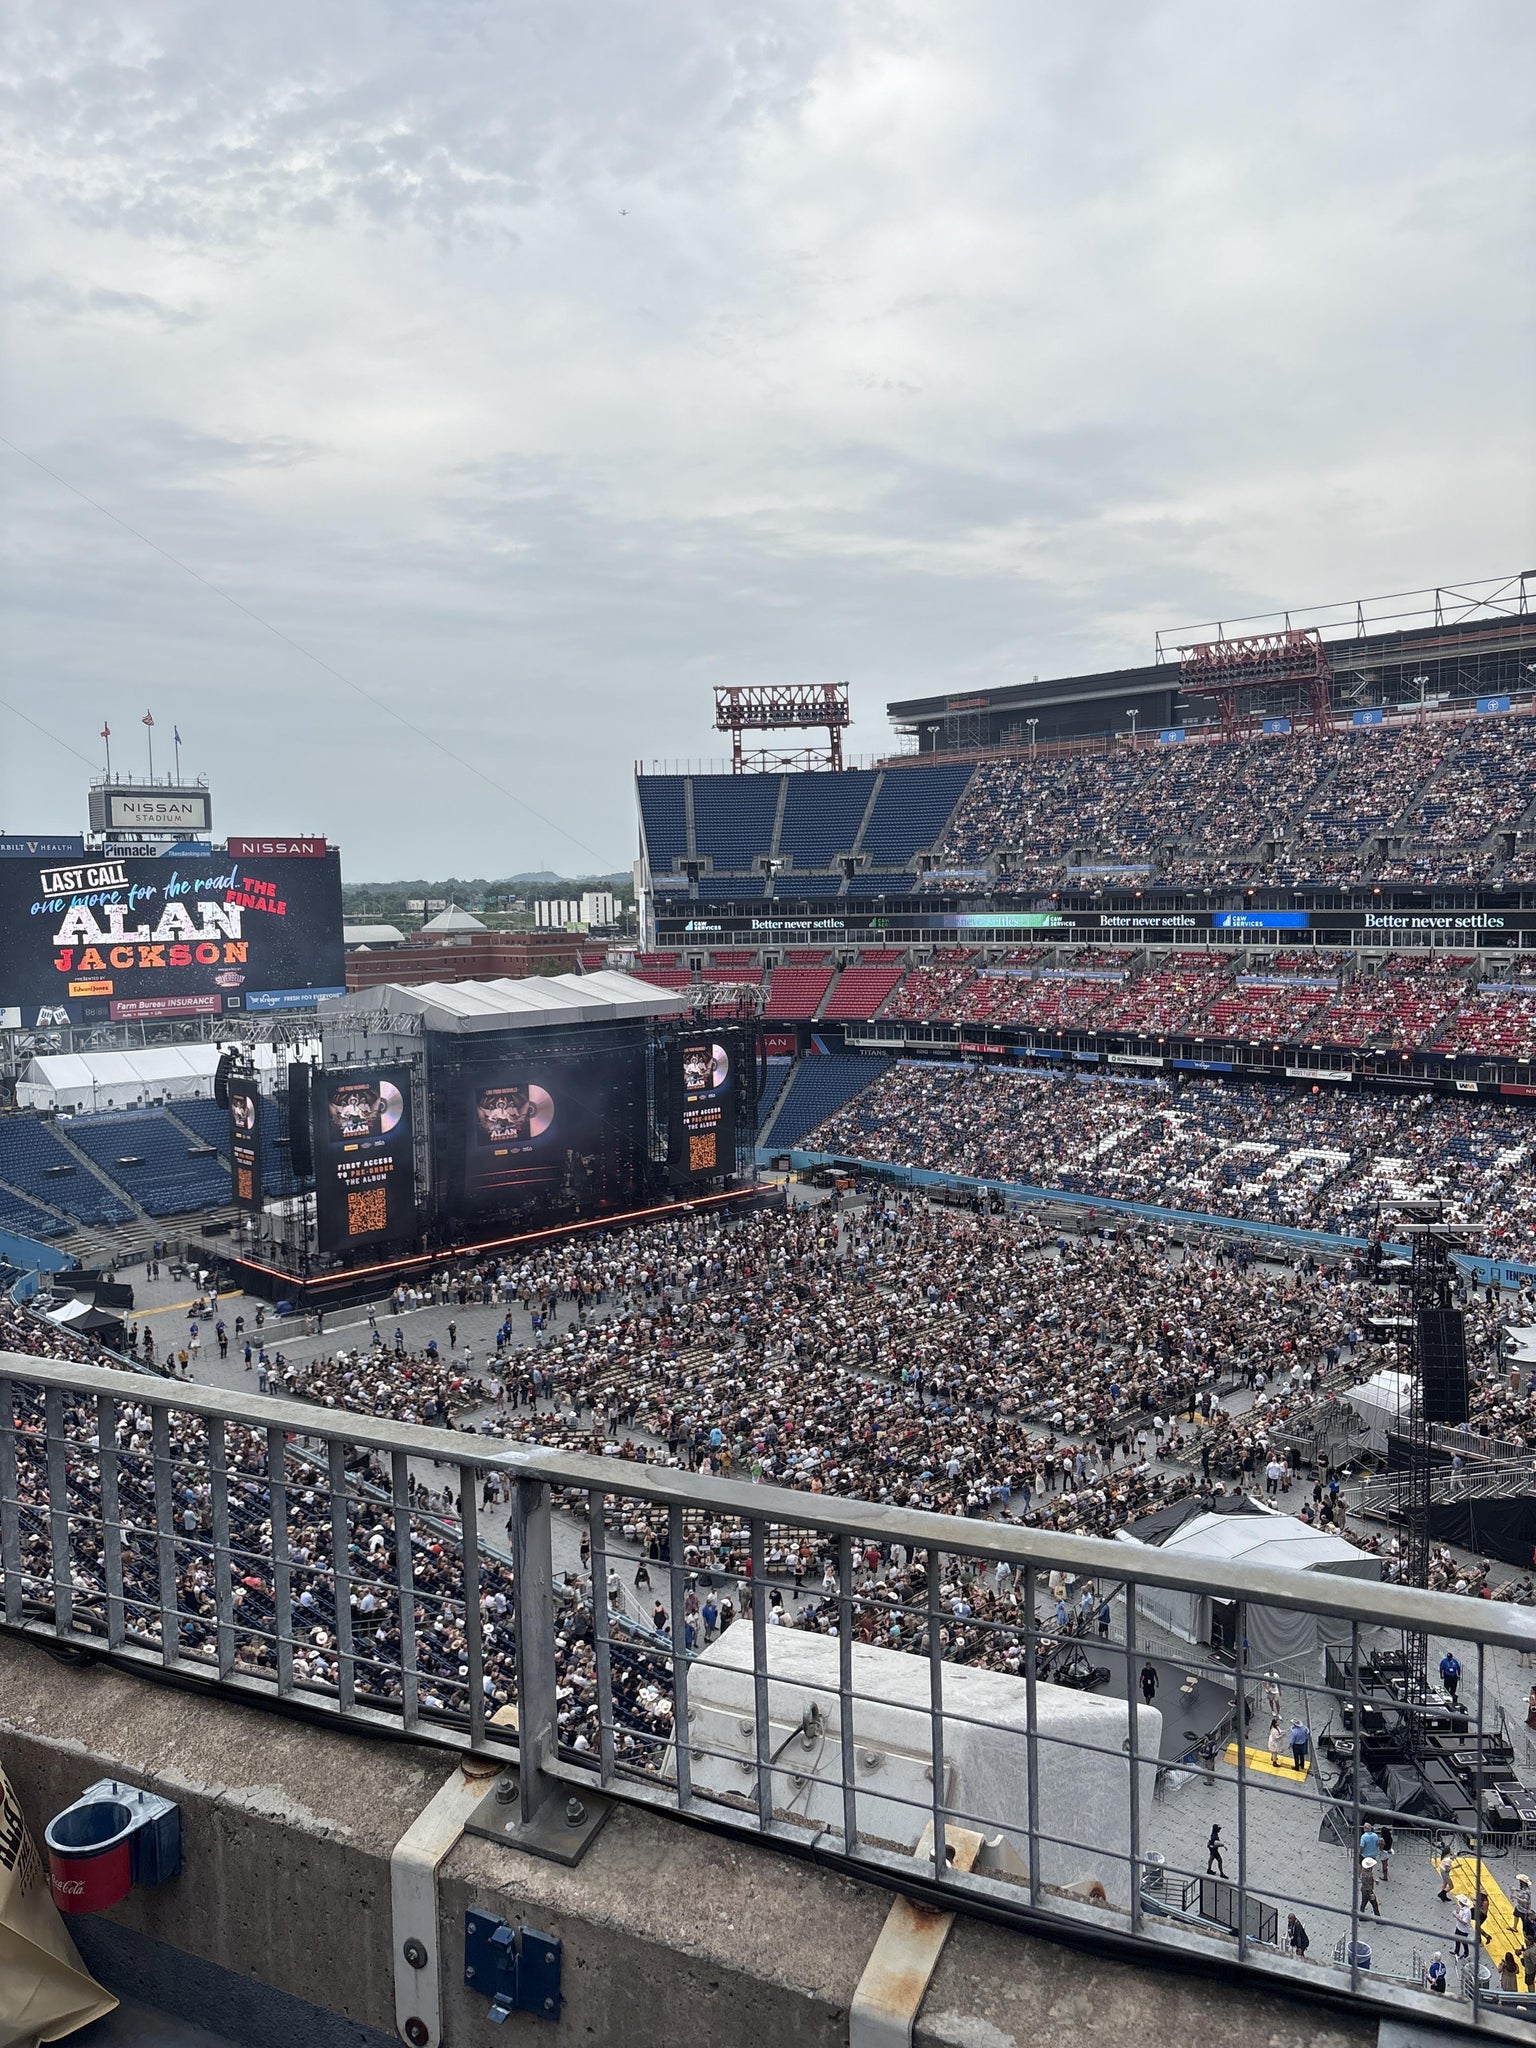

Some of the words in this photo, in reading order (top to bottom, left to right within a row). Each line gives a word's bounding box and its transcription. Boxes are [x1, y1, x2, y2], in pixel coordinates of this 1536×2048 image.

[123, 803, 193, 813] NISSAN
[105, 844, 157, 857] Pinnacle
[242, 843, 314, 854] NISSAN
[41, 871, 83, 893] LAST
[87, 864, 129, 887] CALL
[30, 898, 66, 916] one
[71, 890, 122, 909] more
[128, 884, 157, 911] for
[163, 871, 191, 900] the
[243, 877, 277, 897] THE
[225, 889, 287, 916] FINALE
[53, 901, 245, 946] ALAN
[752, 919, 783, 930] Better
[785, 921, 812, 929] never
[813, 919, 845, 929] settles
[1100, 915, 1131, 926] Better
[1132, 917, 1161, 926] never
[1162, 915, 1195, 926] settles
[1365, 914, 1410, 927] Better
[1411, 916, 1453, 928] never
[1455, 914, 1504, 928] settles
[53, 941, 249, 972] JACKSON
[116, 1002, 137, 1011] Farm
[138, 1001, 166, 1010] Bureau
[167, 997, 215, 1007] INSURANCE
[260, 993, 281, 1007] Kroger
[683, 1110, 699, 1118] FIRST
[700, 1106, 721, 1115] ACCESS
[343, 1124, 369, 1134] ALAN
[699, 1120, 717, 1129] ALBUM
[490, 1128, 517, 1138] ALAN
[337, 1161, 361, 1171] FIRST
[363, 1156, 393, 1167] ACCESS
[350, 1164, 394, 1177] PRE-ORDER
[345, 1177, 360, 1186] THE
[362, 1173, 387, 1184] ALBUM
[51, 1873, 86, 1895] Coca-Cola
